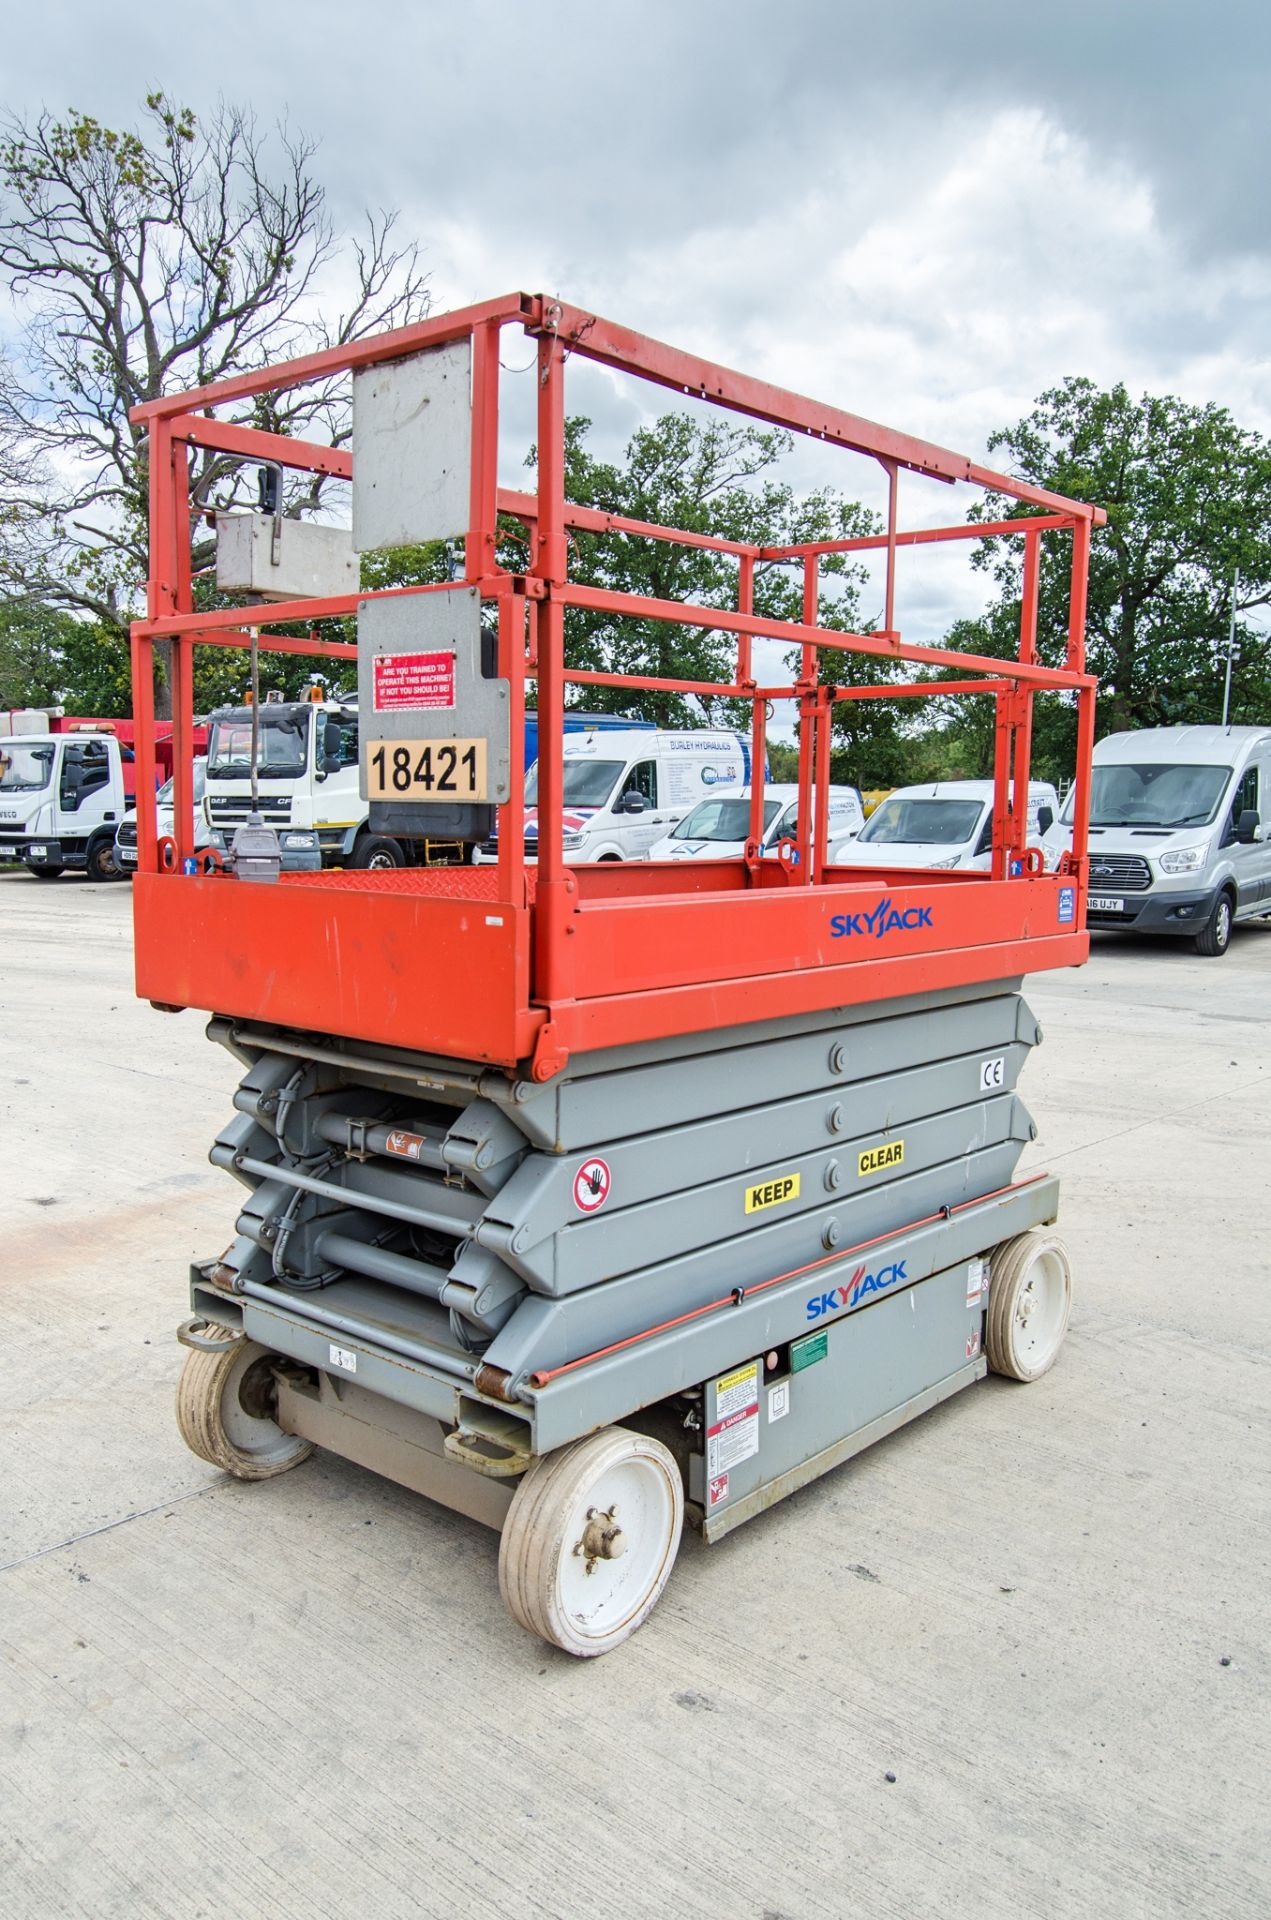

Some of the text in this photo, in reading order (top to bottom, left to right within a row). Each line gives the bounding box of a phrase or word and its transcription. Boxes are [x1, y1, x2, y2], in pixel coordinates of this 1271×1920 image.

[377, 677, 404, 686] OPERATE
[405, 676, 420, 684] THIS
[382, 664, 446, 676] ARE YOU TRAINED TO
[380, 688, 385, 696] IF
[386, 687, 398, 696] NOT
[400, 687, 412, 695] YOU
[413, 685, 438, 694] SHOULD
[670, 741, 694, 750] BURLEY
[372, 745, 476, 791] 18421
[830, 897, 934, 939] SKYJACK
[1099, 900, 1118, 909] UJY
[984, 1060, 1002, 1087] CE
[860, 1145, 903, 1172] CLEAR
[751, 1179, 793, 1208] KEEP
[806, 1259, 908, 1321] SKYJACK
